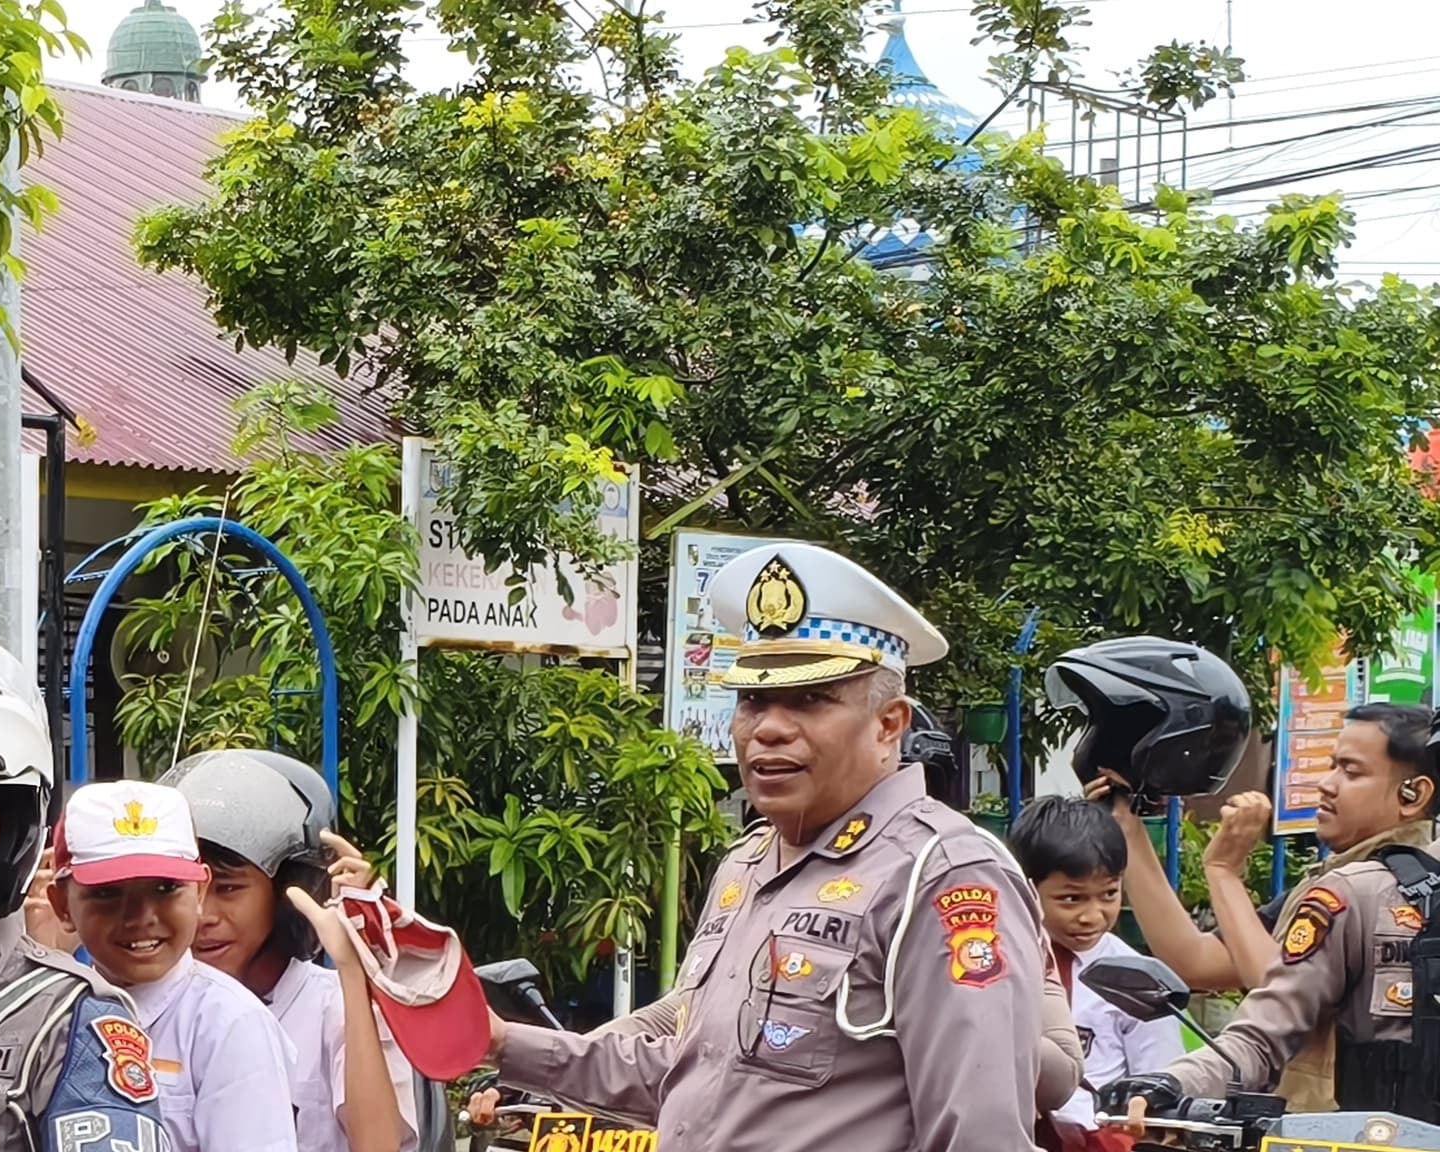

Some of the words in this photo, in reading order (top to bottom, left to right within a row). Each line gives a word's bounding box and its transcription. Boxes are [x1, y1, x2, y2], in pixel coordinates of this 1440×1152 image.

[697, 571, 709, 592] 7
[427, 598, 480, 626] PADA
[484, 601, 538, 629] ANAK
[940, 888, 993, 909] POLDA
[781, 911, 852, 945] POLRI
[950, 911, 993, 928] RIAU
[103, 1022, 147, 1046] POLDA
